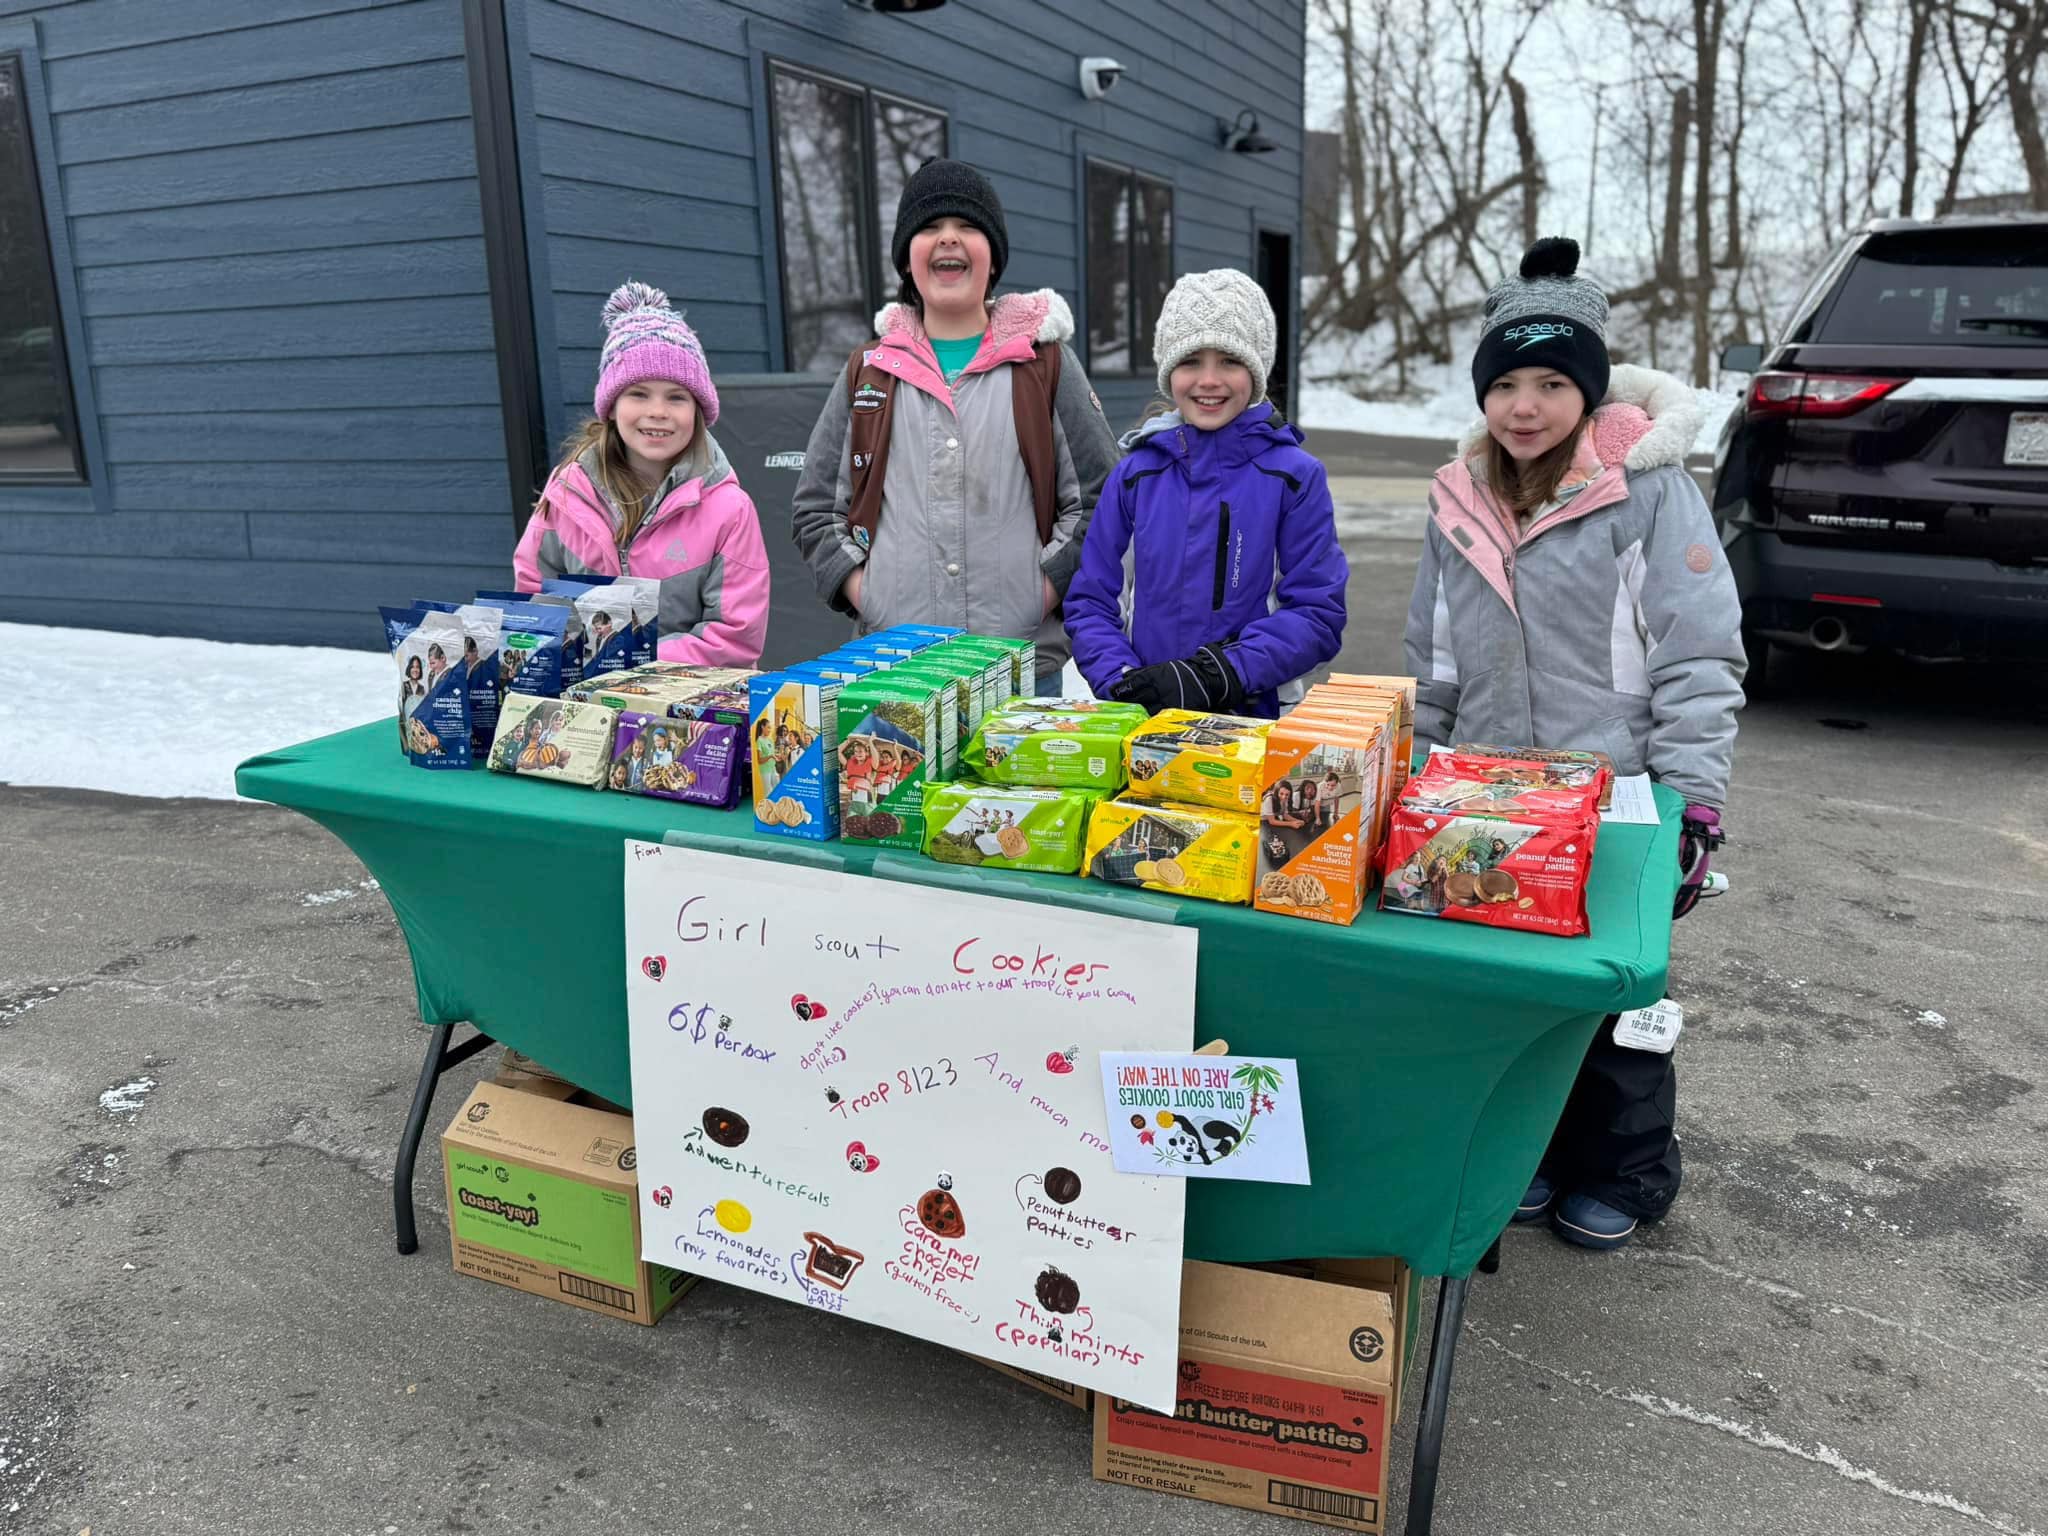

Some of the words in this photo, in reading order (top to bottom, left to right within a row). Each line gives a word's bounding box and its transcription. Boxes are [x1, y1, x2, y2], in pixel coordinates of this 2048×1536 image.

[1503, 322, 1573, 341] speedo
[764, 455, 806, 468] LENNOX
[1808, 514, 1890, 529] TRAVERSE
[1232, 529, 1242, 588] obermeyer
[1323, 842, 1352, 854] peanut
[1327, 849, 1352, 860] butter
[1311, 855, 1351, 866] sandwich
[1516, 853, 1546, 862] peanut
[1548, 855, 1576, 864] butter
[677, 896, 766, 946] Girl
[953, 937, 1110, 986] Cookies
[668, 1002, 715, 1044] 6$
[1638, 1010, 1654, 1021] FEB
[1656, 1014, 1665, 1024] 10
[1652, 1025, 1666, 1036] PM
[897, 1059, 958, 1094] 8123
[1117, 1066, 1148, 1086] WAY!
[1152, 1067, 1178, 1086] THE
[1182, 1067, 1200, 1087] ON
[1205, 1069, 1230, 1088] ARE
[974, 1052, 1023, 1093] And
[1030, 1096, 1069, 1127] much
[1119, 1087, 1169, 1107] COOKIES
[1174, 1089, 1214, 1108] SCOUT
[1217, 1090, 1244, 1110] GIRL
[460, 1189, 537, 1224] toast-yay!
[697, 1218, 781, 1268] Lemonades
[460, 1261, 475, 1272] NOT
[477, 1266, 492, 1275] FOR
[493, 1271, 520, 1284] RESALE
[1071, 1329, 1144, 1366] mints
[1207, 1331, 1229, 1342] Scouts
[1231, 1334, 1238, 1343] of
[1240, 1336, 1251, 1345] the
[1200, 1403, 1274, 1432] butter
[1278, 1422, 1363, 1450] patties
[1107, 1449, 1119, 1457] Girl
[1120, 1451, 1142, 1461] Scouts
[1143, 1454, 1161, 1466] bring
[1162, 1457, 1178, 1467] their
[1179, 1461, 1204, 1473] dreams
[1107, 1457, 1118, 1466] Get
[1119, 1459, 1142, 1469] started
[1151, 1465, 1169, 1475] yours
[1107, 1469, 1129, 1481] NOT
[1131, 1473, 1153, 1485] FOR
[1156, 1478, 1197, 1493] RESALE
